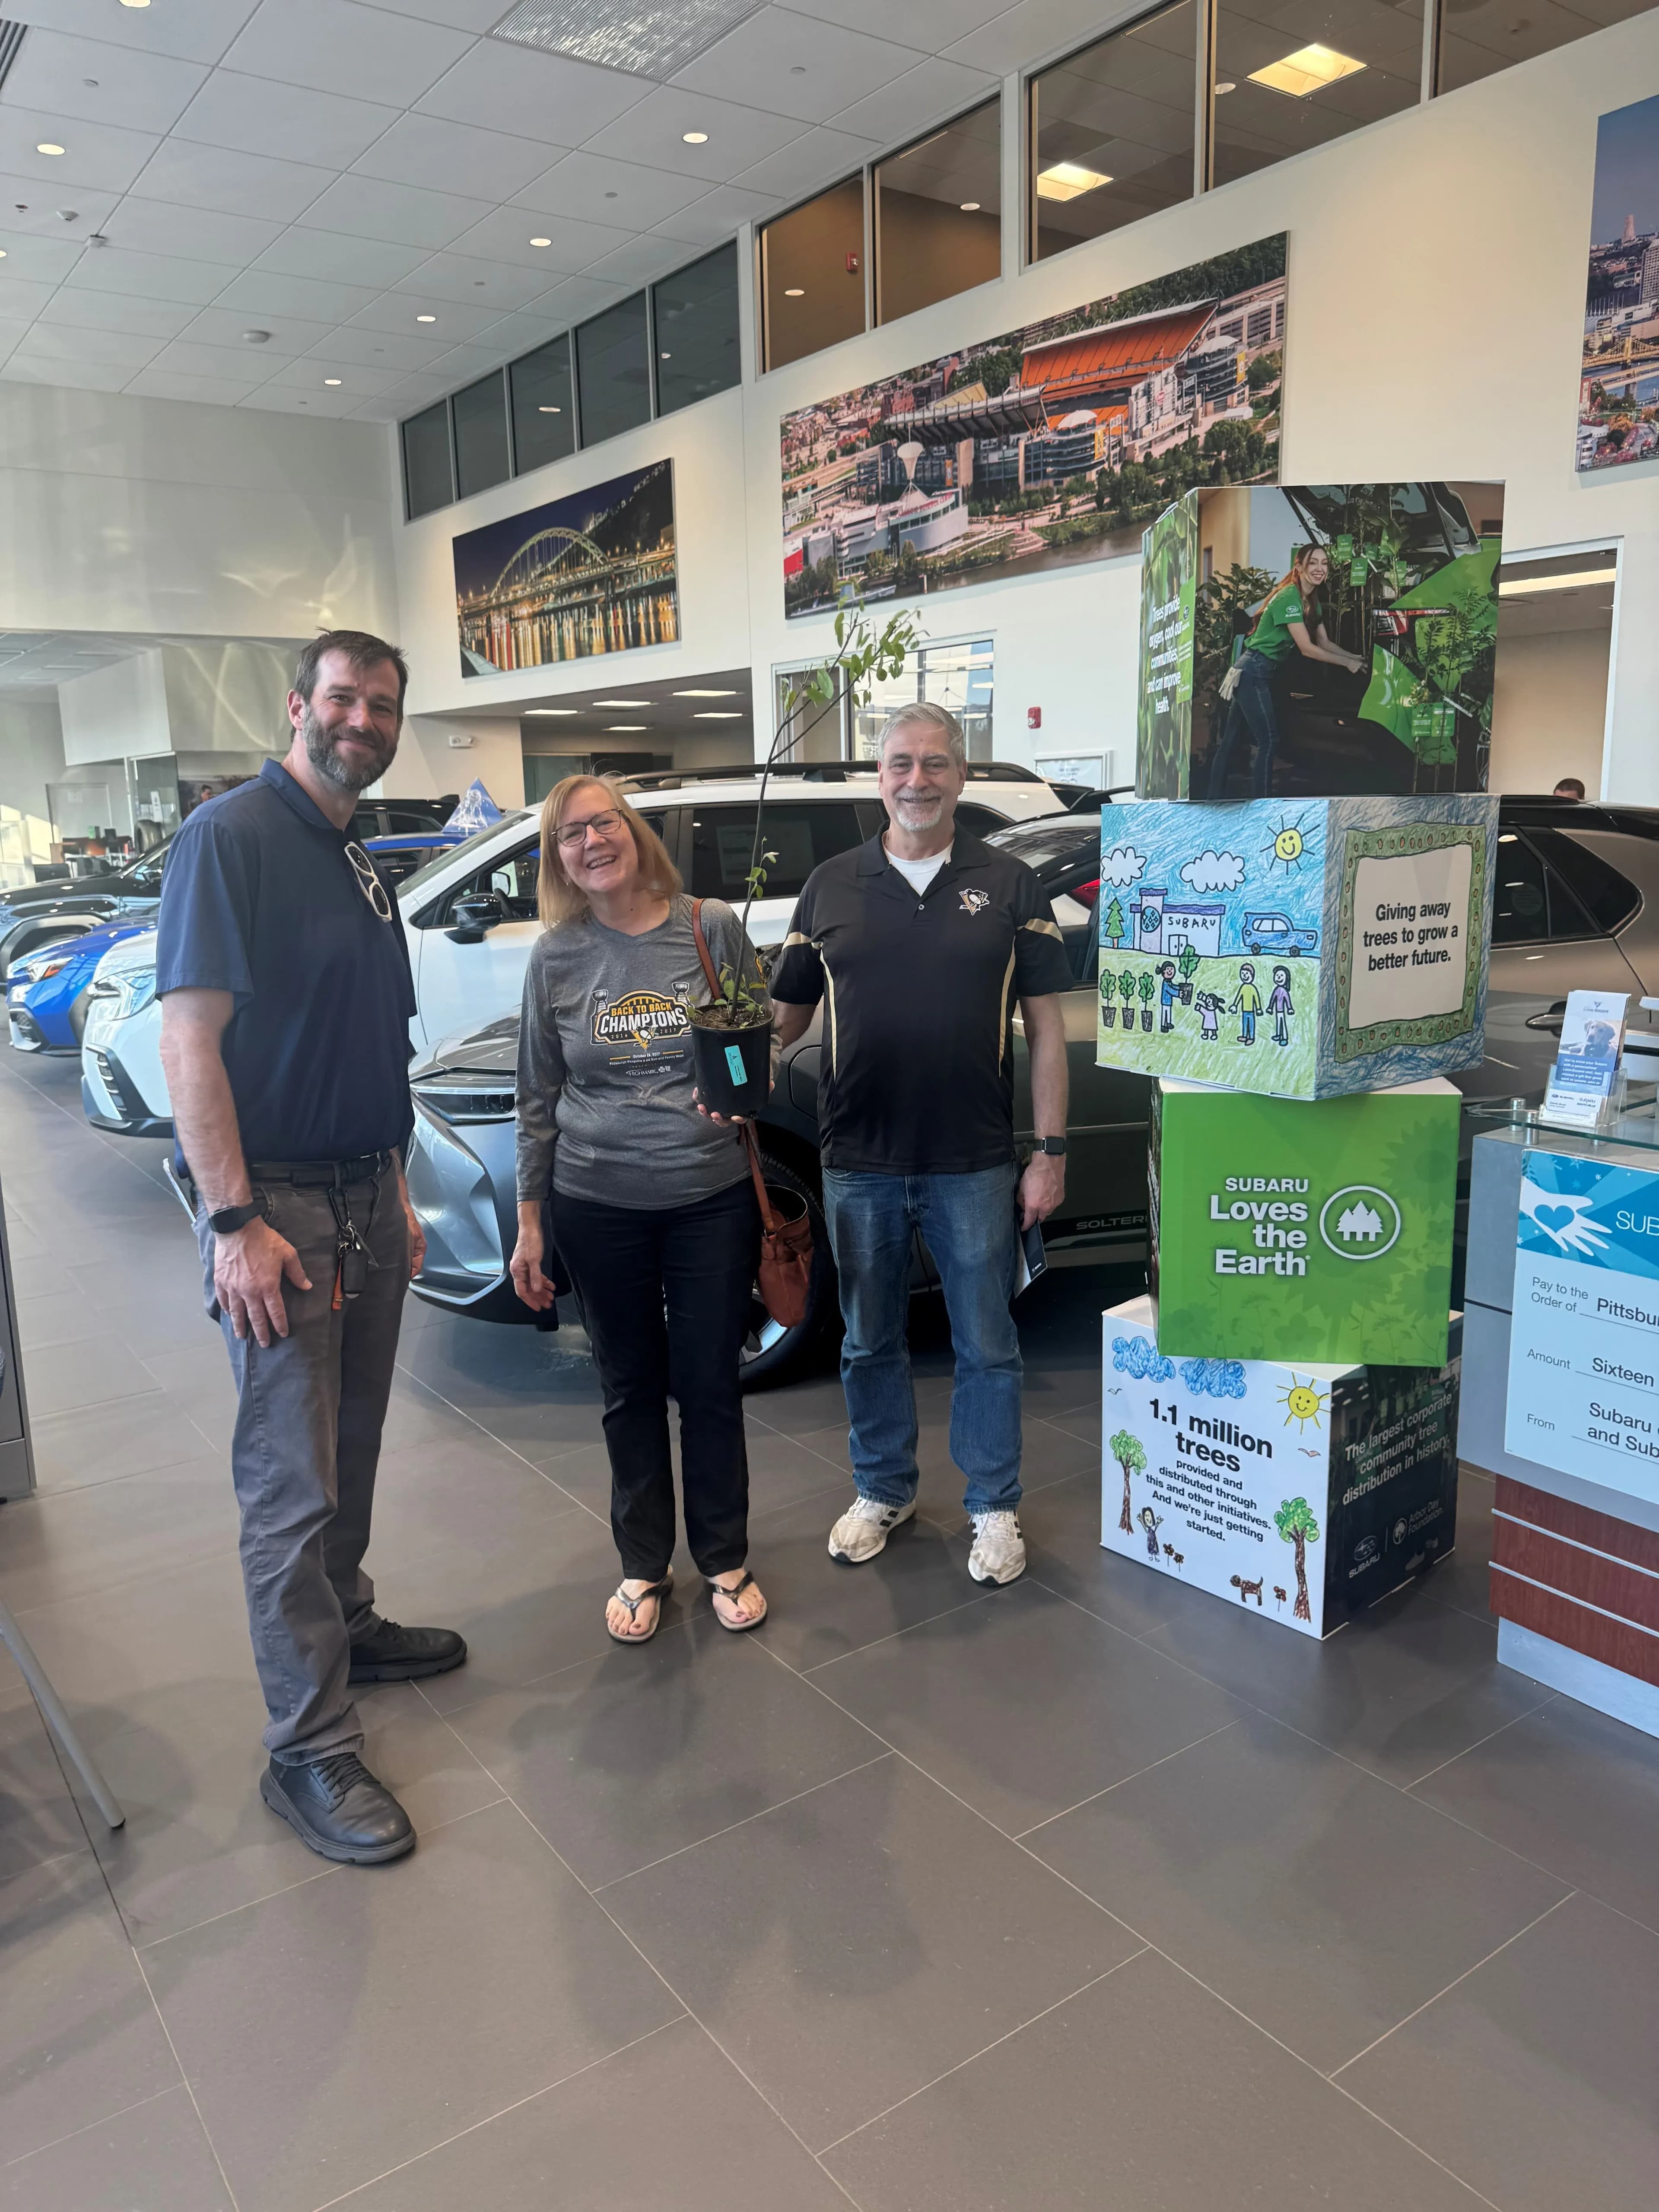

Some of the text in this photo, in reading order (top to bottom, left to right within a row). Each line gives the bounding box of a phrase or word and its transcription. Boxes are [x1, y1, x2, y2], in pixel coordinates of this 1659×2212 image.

[1153, 594, 1180, 623] Trees provide
[1165, 621, 1174, 640] cool
[1151, 646, 1178, 670] communities,
[1163, 671, 1181, 691] improve
[1155, 696, 1169, 714] health.
[1168, 916, 1216, 930] SUBARU
[1376, 902, 1451, 922] Giving away
[1363, 925, 1459, 947] trees to grow a
[1368, 949, 1451, 972] better future.
[600, 1007, 687, 1034] CHAMPIONS
[611, 1002, 672, 1017] BACK TO BACK
[1225, 1177, 1309, 1193] SUBARU
[1210, 1195, 1308, 1222] Loves
[1076, 1215, 1147, 1230] SOLTER
[1252, 1223, 1307, 1249] the
[1215, 1249, 1306, 1276] Earth
[1532, 1276, 1589, 1300] Pay to the
[1531, 1291, 1577, 1313] Order of
[1527, 1348, 1571, 1370] Amount
[1592, 1357, 1655, 1387] Sixteen
[1149, 1398, 1273, 1459] 1.1 million
[1344, 1441, 1366, 1462] The
[1368, 1417, 1404, 1449] largest
[1406, 1393, 1452, 1428] corporate
[1527, 1413, 1555, 1431] From
[1589, 1402, 1652, 1433] Subaru
[1360, 1432, 1417, 1475] community
[1418, 1421, 1438, 1441] tree
[1587, 1427, 1620, 1446] and
[1175, 1431, 1240, 1472] trees
[1176, 1459, 1243, 1491] provided and
[1342, 1461, 1402, 1506] distribution
[1404, 1454, 1414, 1469] in
[1416, 1433, 1450, 1462] history.
[1159, 1466, 1258, 1510] distributed through
[1146, 1473, 1271, 1530] this and other initiatives.
[1408, 1498, 1440, 1525] Arbor Day
[1152, 1490, 1264, 1543] And we're just getting
[1186, 1519, 1226, 1541] started.
[1348, 1552, 1381, 1578] SUBARU
